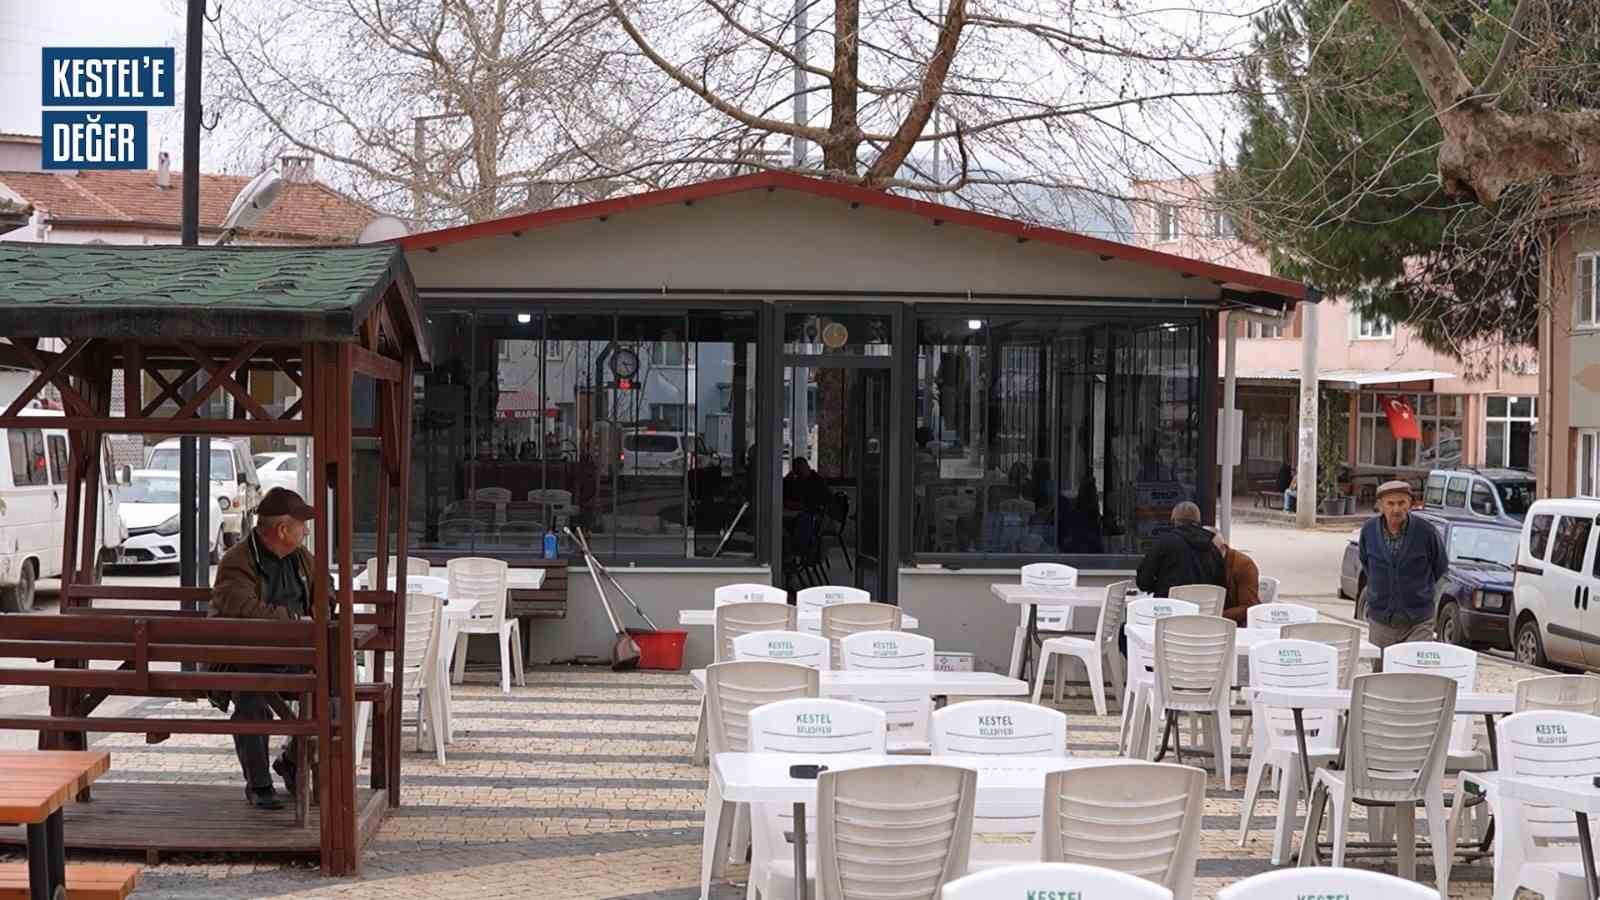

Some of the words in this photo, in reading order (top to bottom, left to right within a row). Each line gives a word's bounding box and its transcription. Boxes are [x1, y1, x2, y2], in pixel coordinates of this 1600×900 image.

[796, 713, 832, 724] KESTEL
[978, 715, 1014, 726] KESTEL
[1535, 724, 1568, 735] KESTEL
